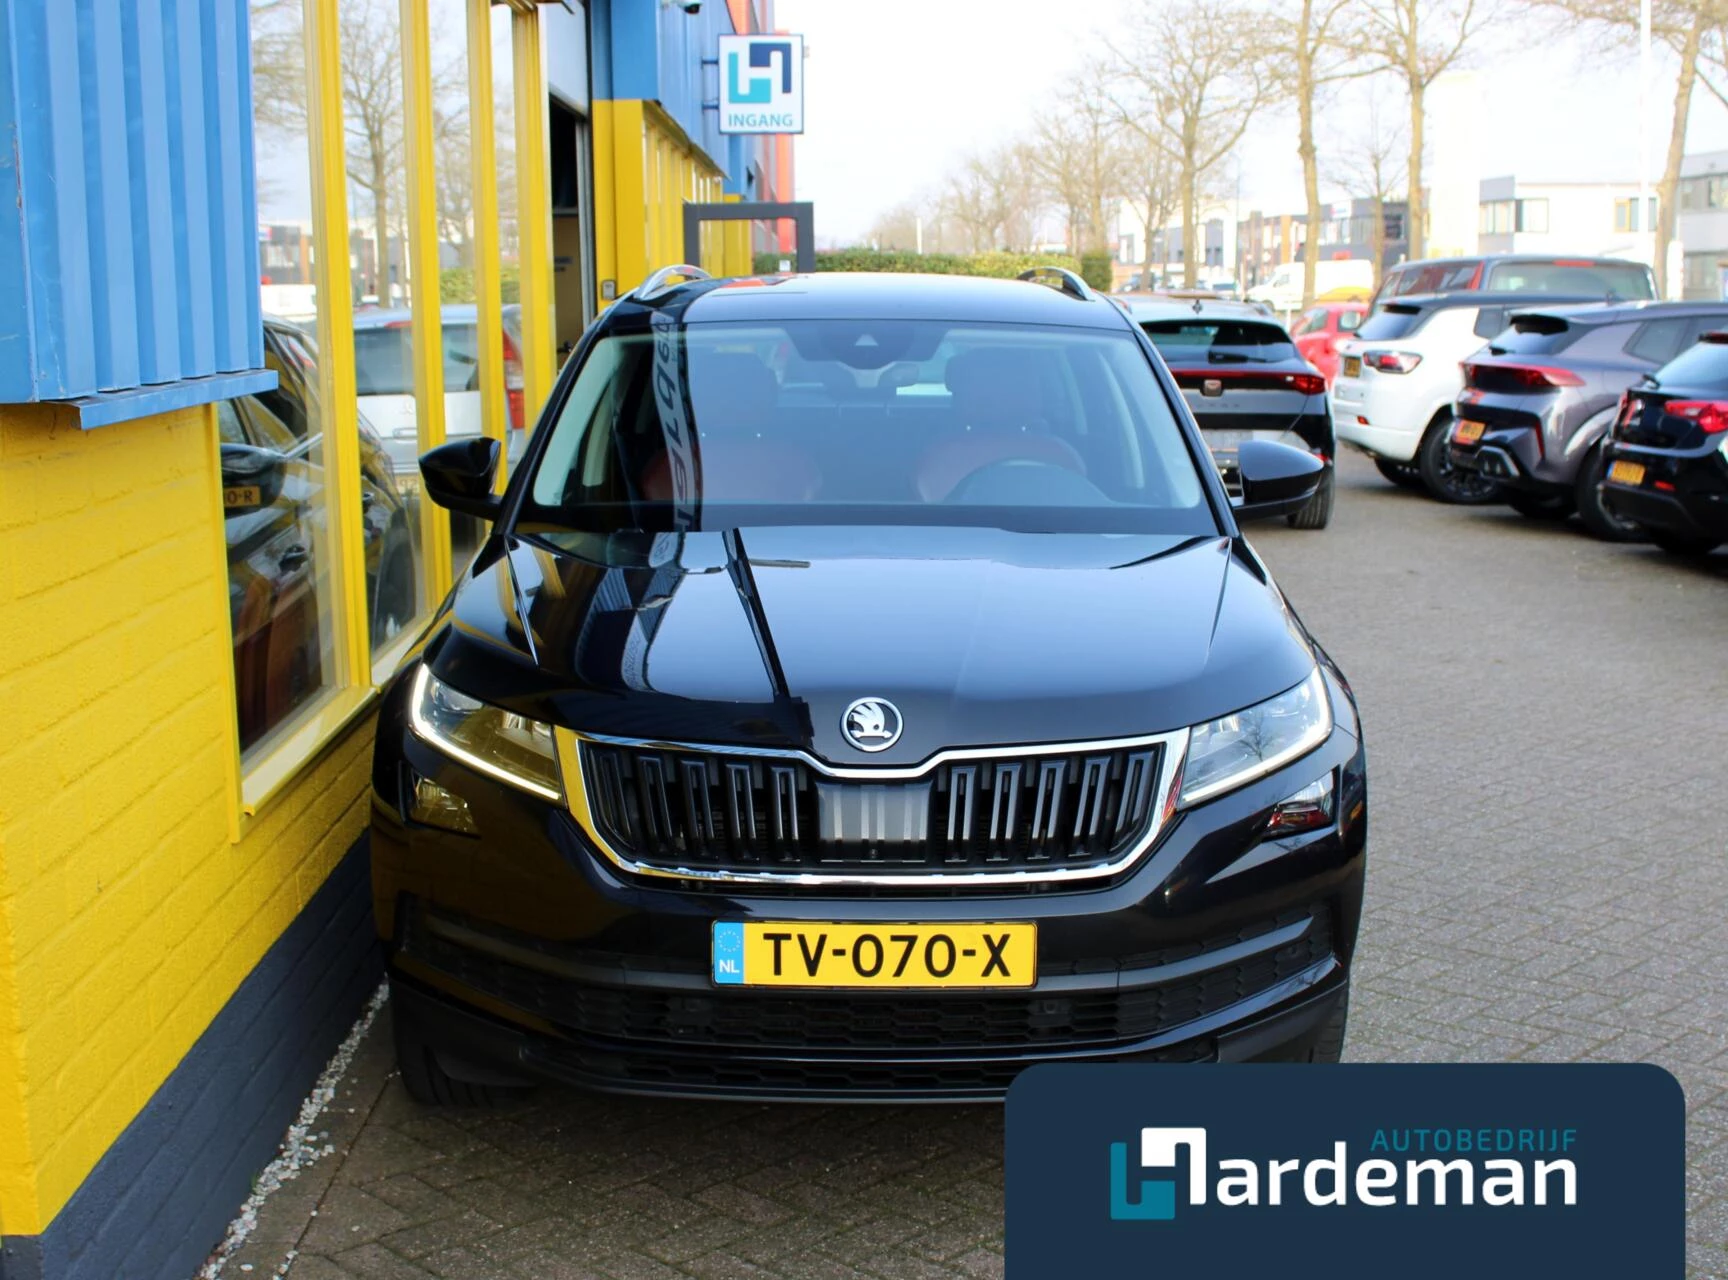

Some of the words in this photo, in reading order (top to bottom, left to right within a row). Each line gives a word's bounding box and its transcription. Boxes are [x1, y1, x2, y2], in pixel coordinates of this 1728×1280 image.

[729, 113, 793, 127] INGANG
[763, 932, 1012, 978] TV-070-X
[719, 960, 740, 974] NL
